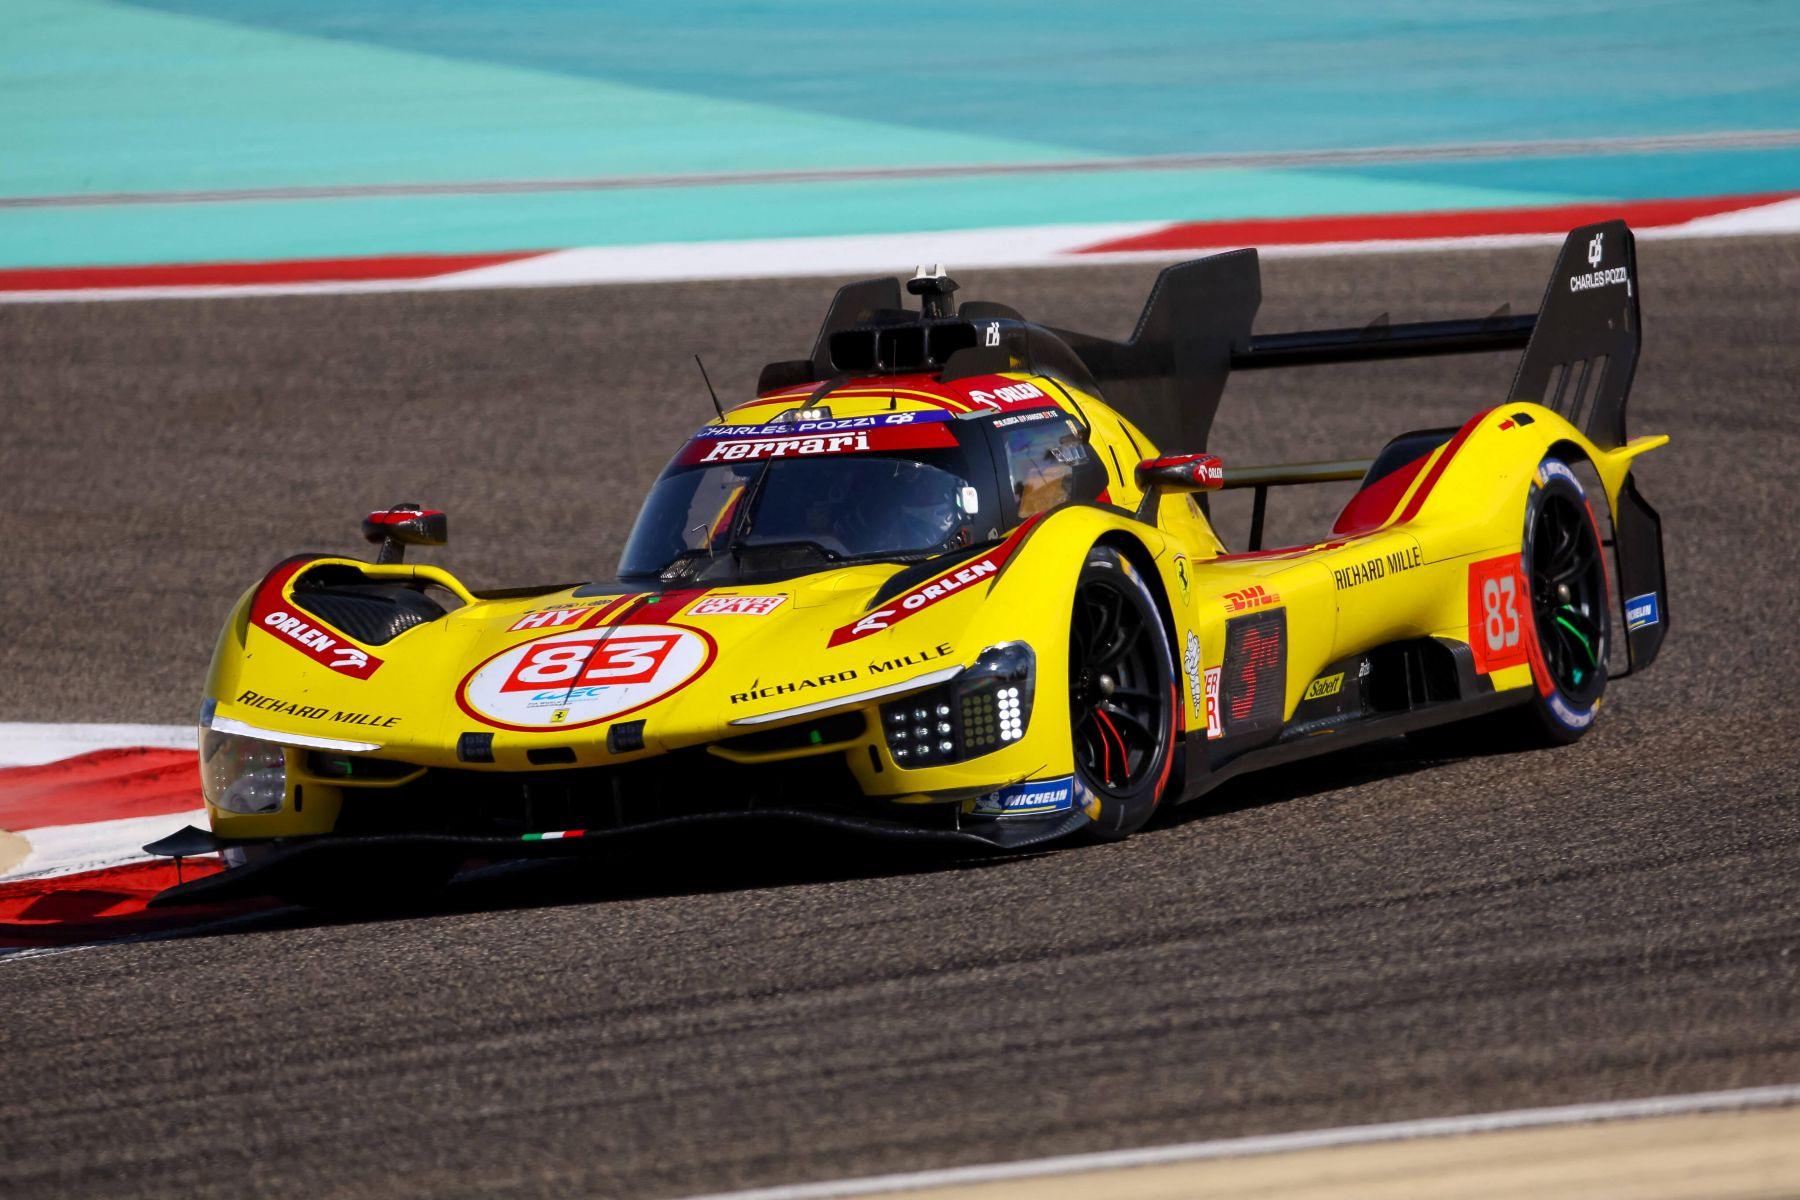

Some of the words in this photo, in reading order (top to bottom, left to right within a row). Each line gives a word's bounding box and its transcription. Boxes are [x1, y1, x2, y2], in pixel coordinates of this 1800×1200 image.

[1570, 270, 1605, 292] CHARLES
[1604, 266, 1627, 285] POZZI
[993, 382, 1044, 404] ORLEN
[798, 417, 876, 432] POZZI
[700, 431, 871, 463] Ferrari
[1208, 467, 1223, 479] ORLEN
[1334, 556, 1385, 591] RICHARD
[1386, 546, 1422, 576] MILLE
[902, 560, 998, 609] ORLEN
[1223, 585, 1274, 612] DHL
[511, 608, 589, 631] HY
[695, 603, 770, 614] CAR
[1483, 575, 1520, 651] 83
[264, 611, 336, 653] ORLEN
[517, 640, 666, 683] 83
[731, 669, 857, 704] RICHARD
[868, 642, 955, 675] MILLE
[236, 690, 329, 721] RICHARD
[329, 711, 402, 728] MILLE
[1005, 788, 1068, 807] MICHELIN
